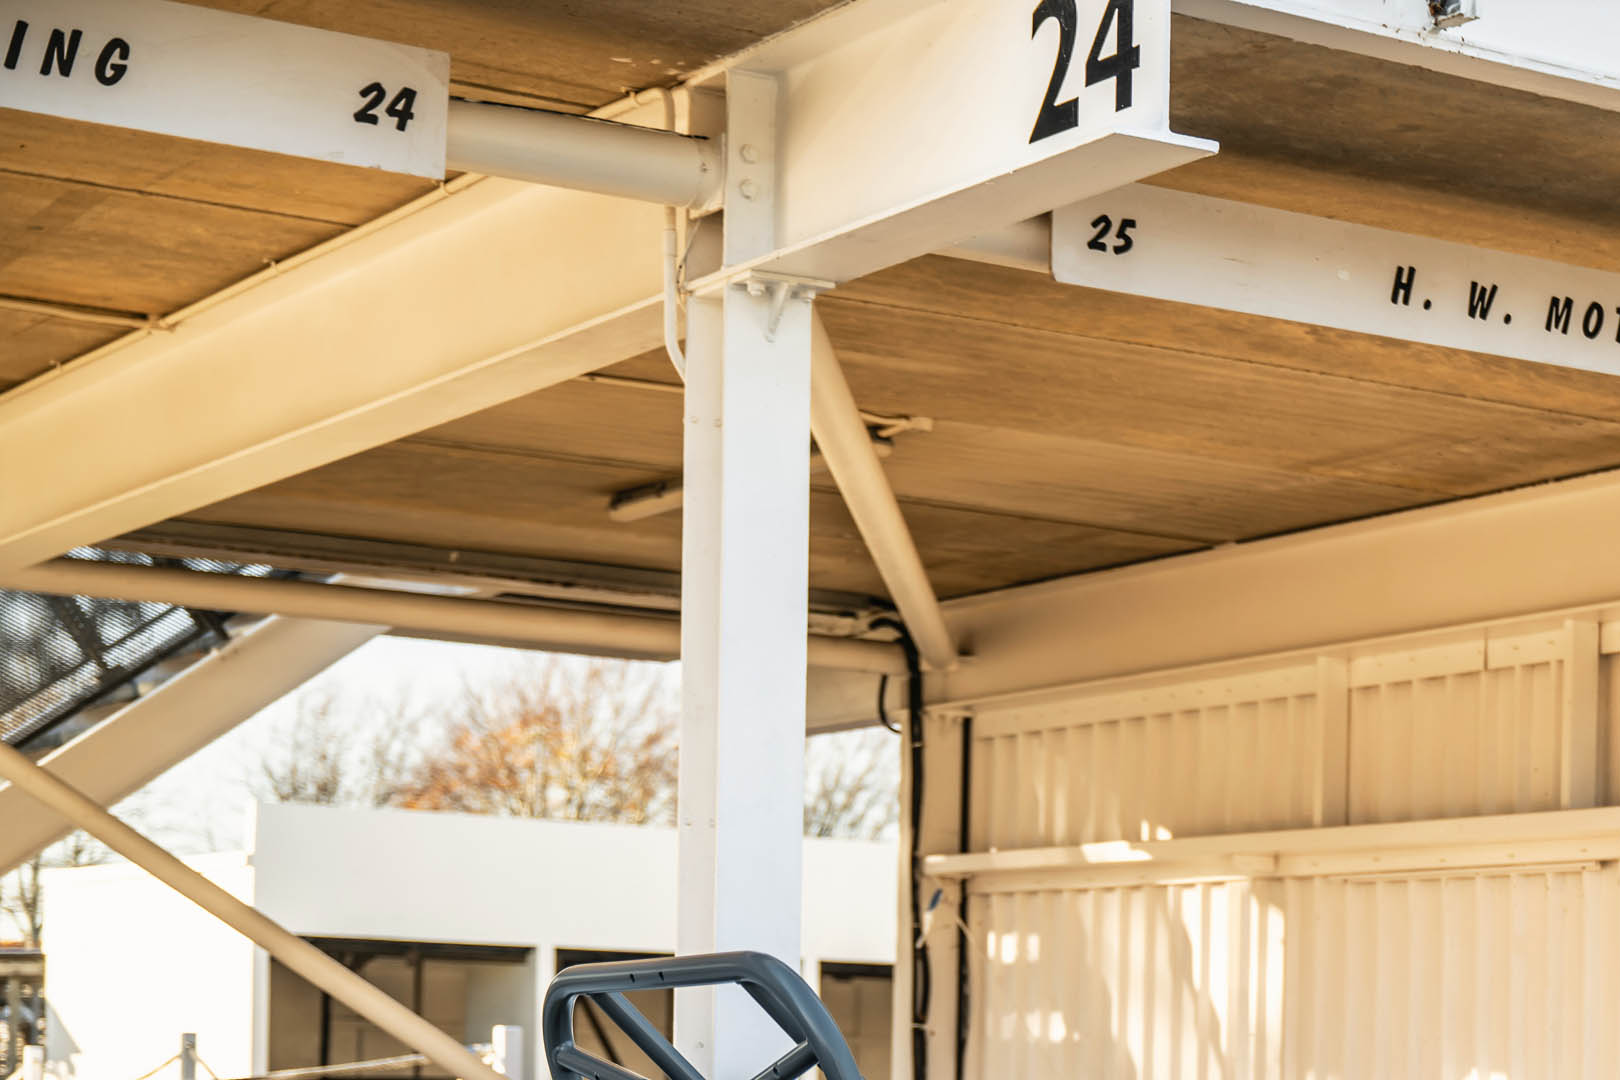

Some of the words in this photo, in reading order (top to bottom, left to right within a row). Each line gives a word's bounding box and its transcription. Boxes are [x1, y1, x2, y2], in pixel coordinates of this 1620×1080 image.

[3, 19, 131, 87] ING
[353, 81, 418, 132] 24
[1028, 0, 1141, 145] 24
[1086, 214, 1137, 256] 25
[1390, 265, 1432, 311] H.
[1467, 280, 1512, 325] W.
